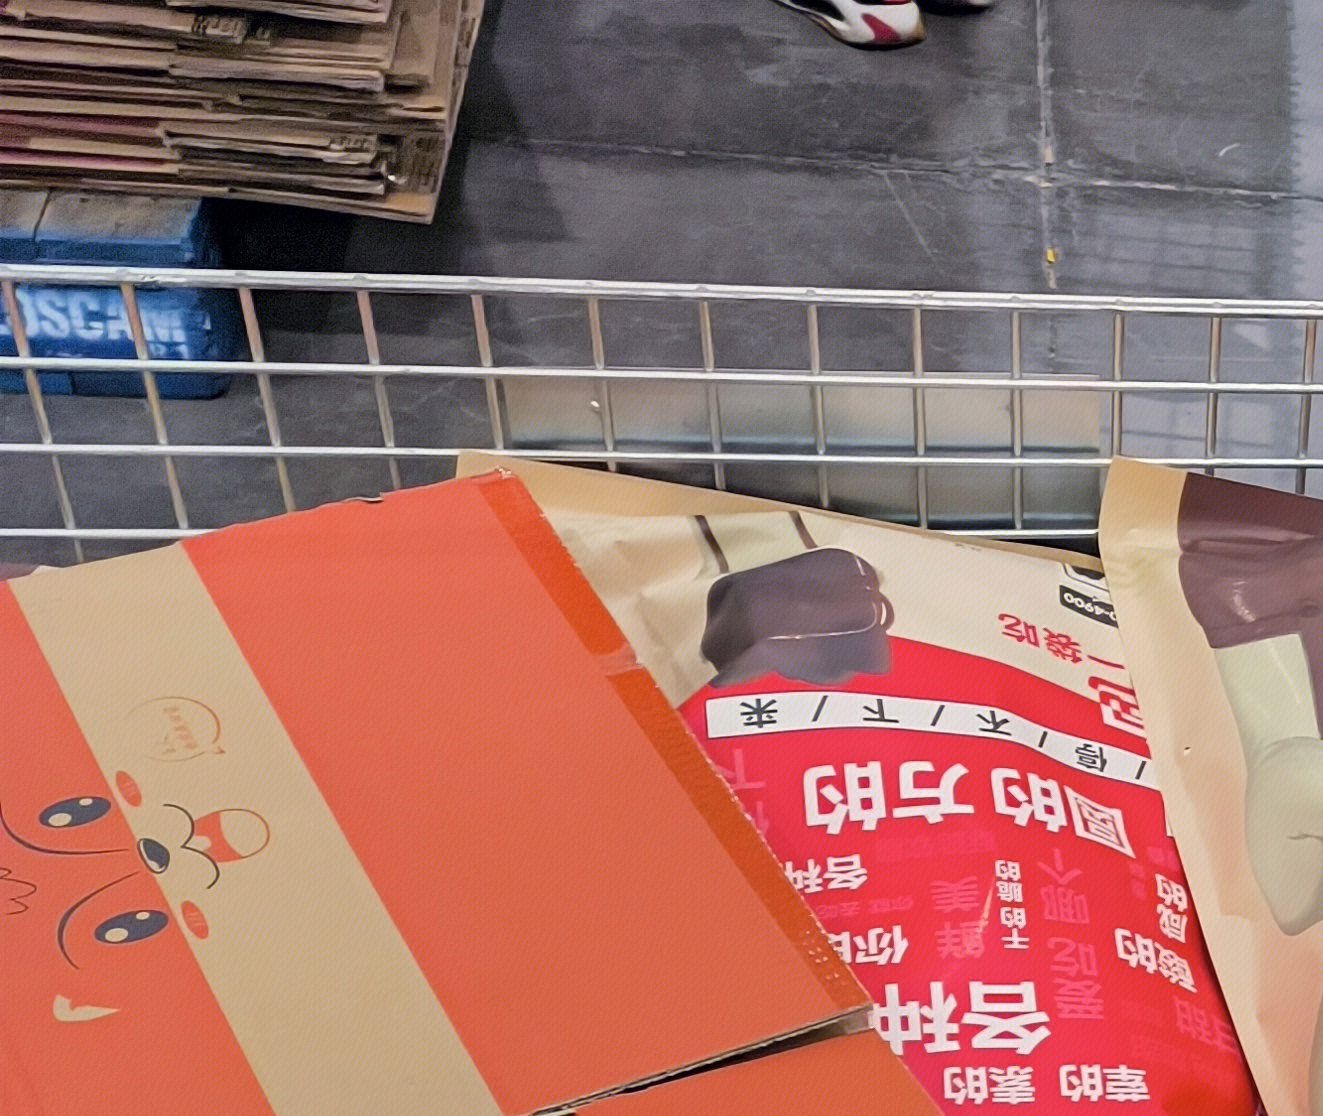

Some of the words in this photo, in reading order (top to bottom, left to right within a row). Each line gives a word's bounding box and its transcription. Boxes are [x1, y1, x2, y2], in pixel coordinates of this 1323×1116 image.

[0, 286, 190, 342] OSCAM
[998, 613, 1125, 670] 一袋吃
[871, 979, 1052, 1056] 各种
[943, 1065, 1036, 1105] 素的
[1058, 1064, 1152, 1104] 荤的
